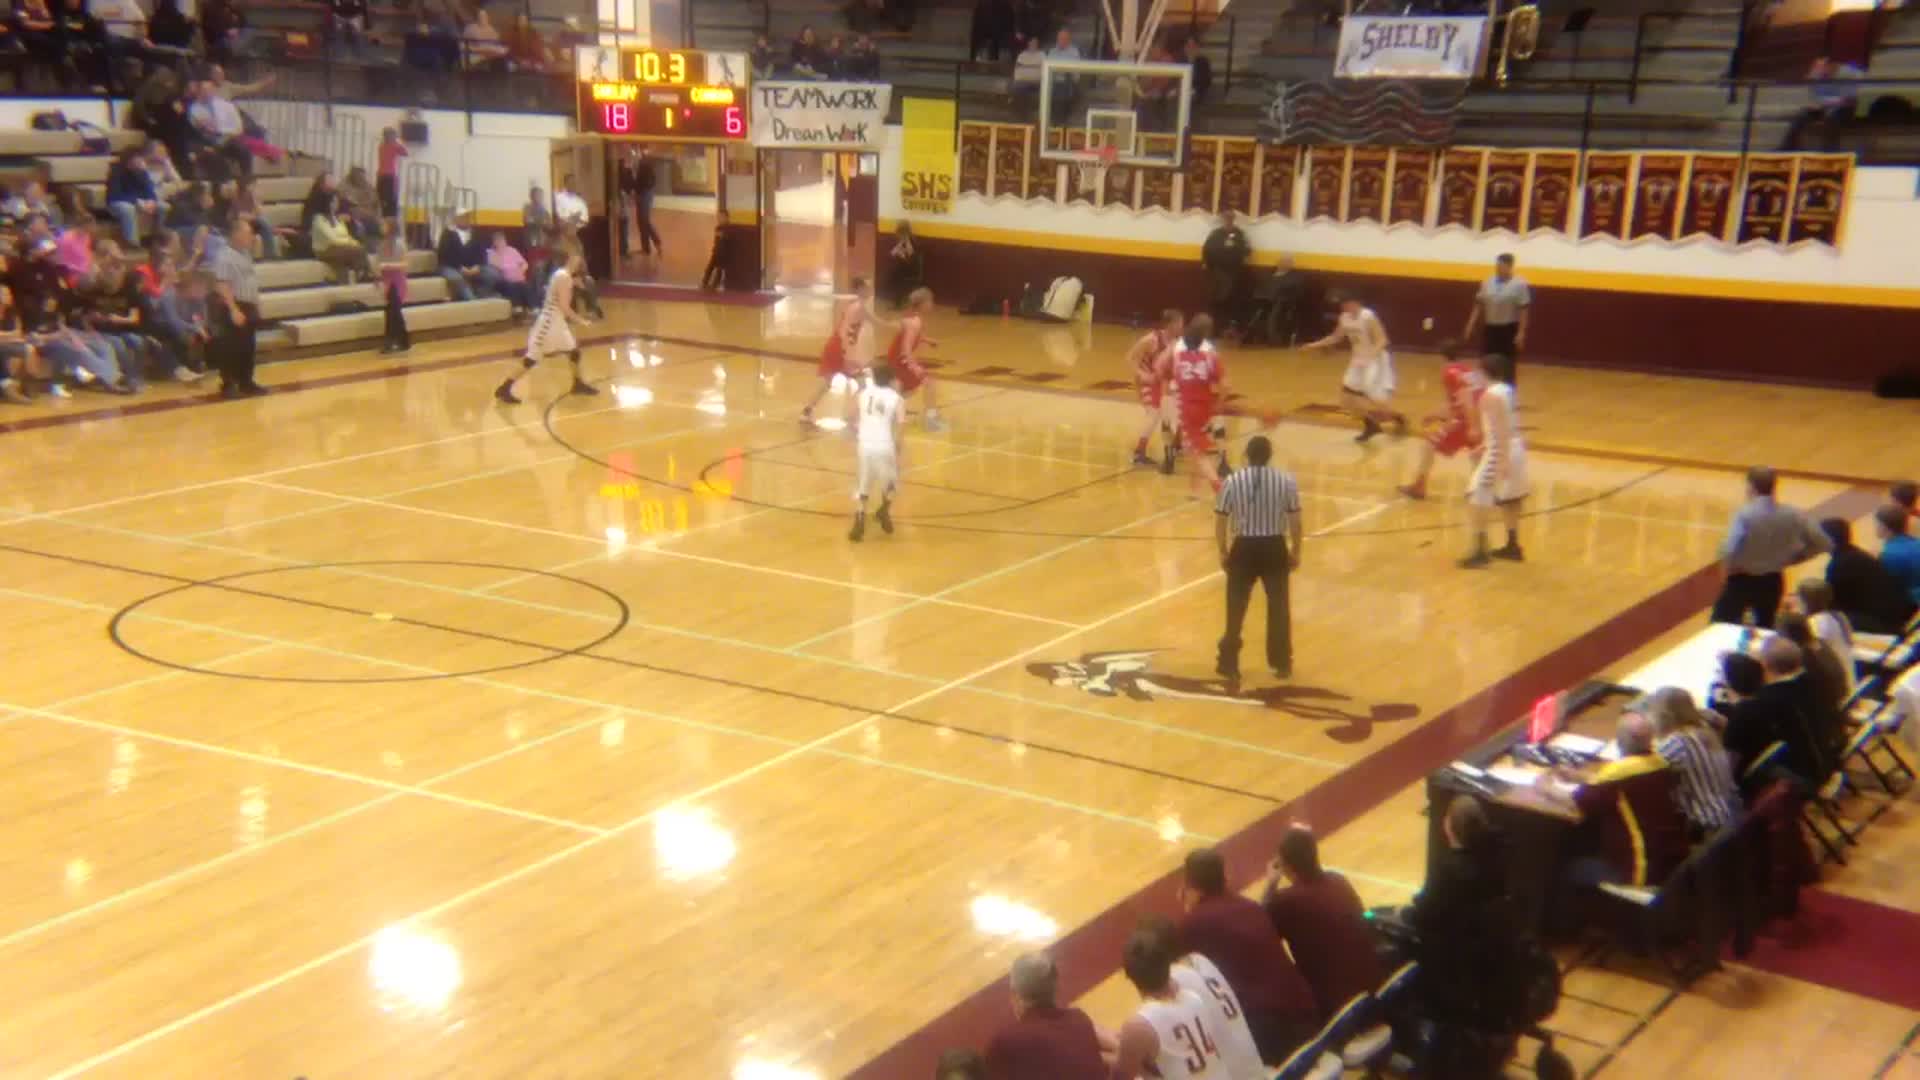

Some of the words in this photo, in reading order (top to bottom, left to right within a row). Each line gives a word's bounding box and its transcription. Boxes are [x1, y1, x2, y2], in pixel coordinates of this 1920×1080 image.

[1360, 22, 1459, 60] SHELBY
[635, 52, 685, 82] 10.3
[759, 87, 878, 109] TEAMWORK
[605, 103, 628, 130] 18
[665, 108, 673, 128] 1
[726, 107, 741, 133] 6
[902, 171, 951, 200] SHS
[1173, 1016, 1221, 1073] 34
